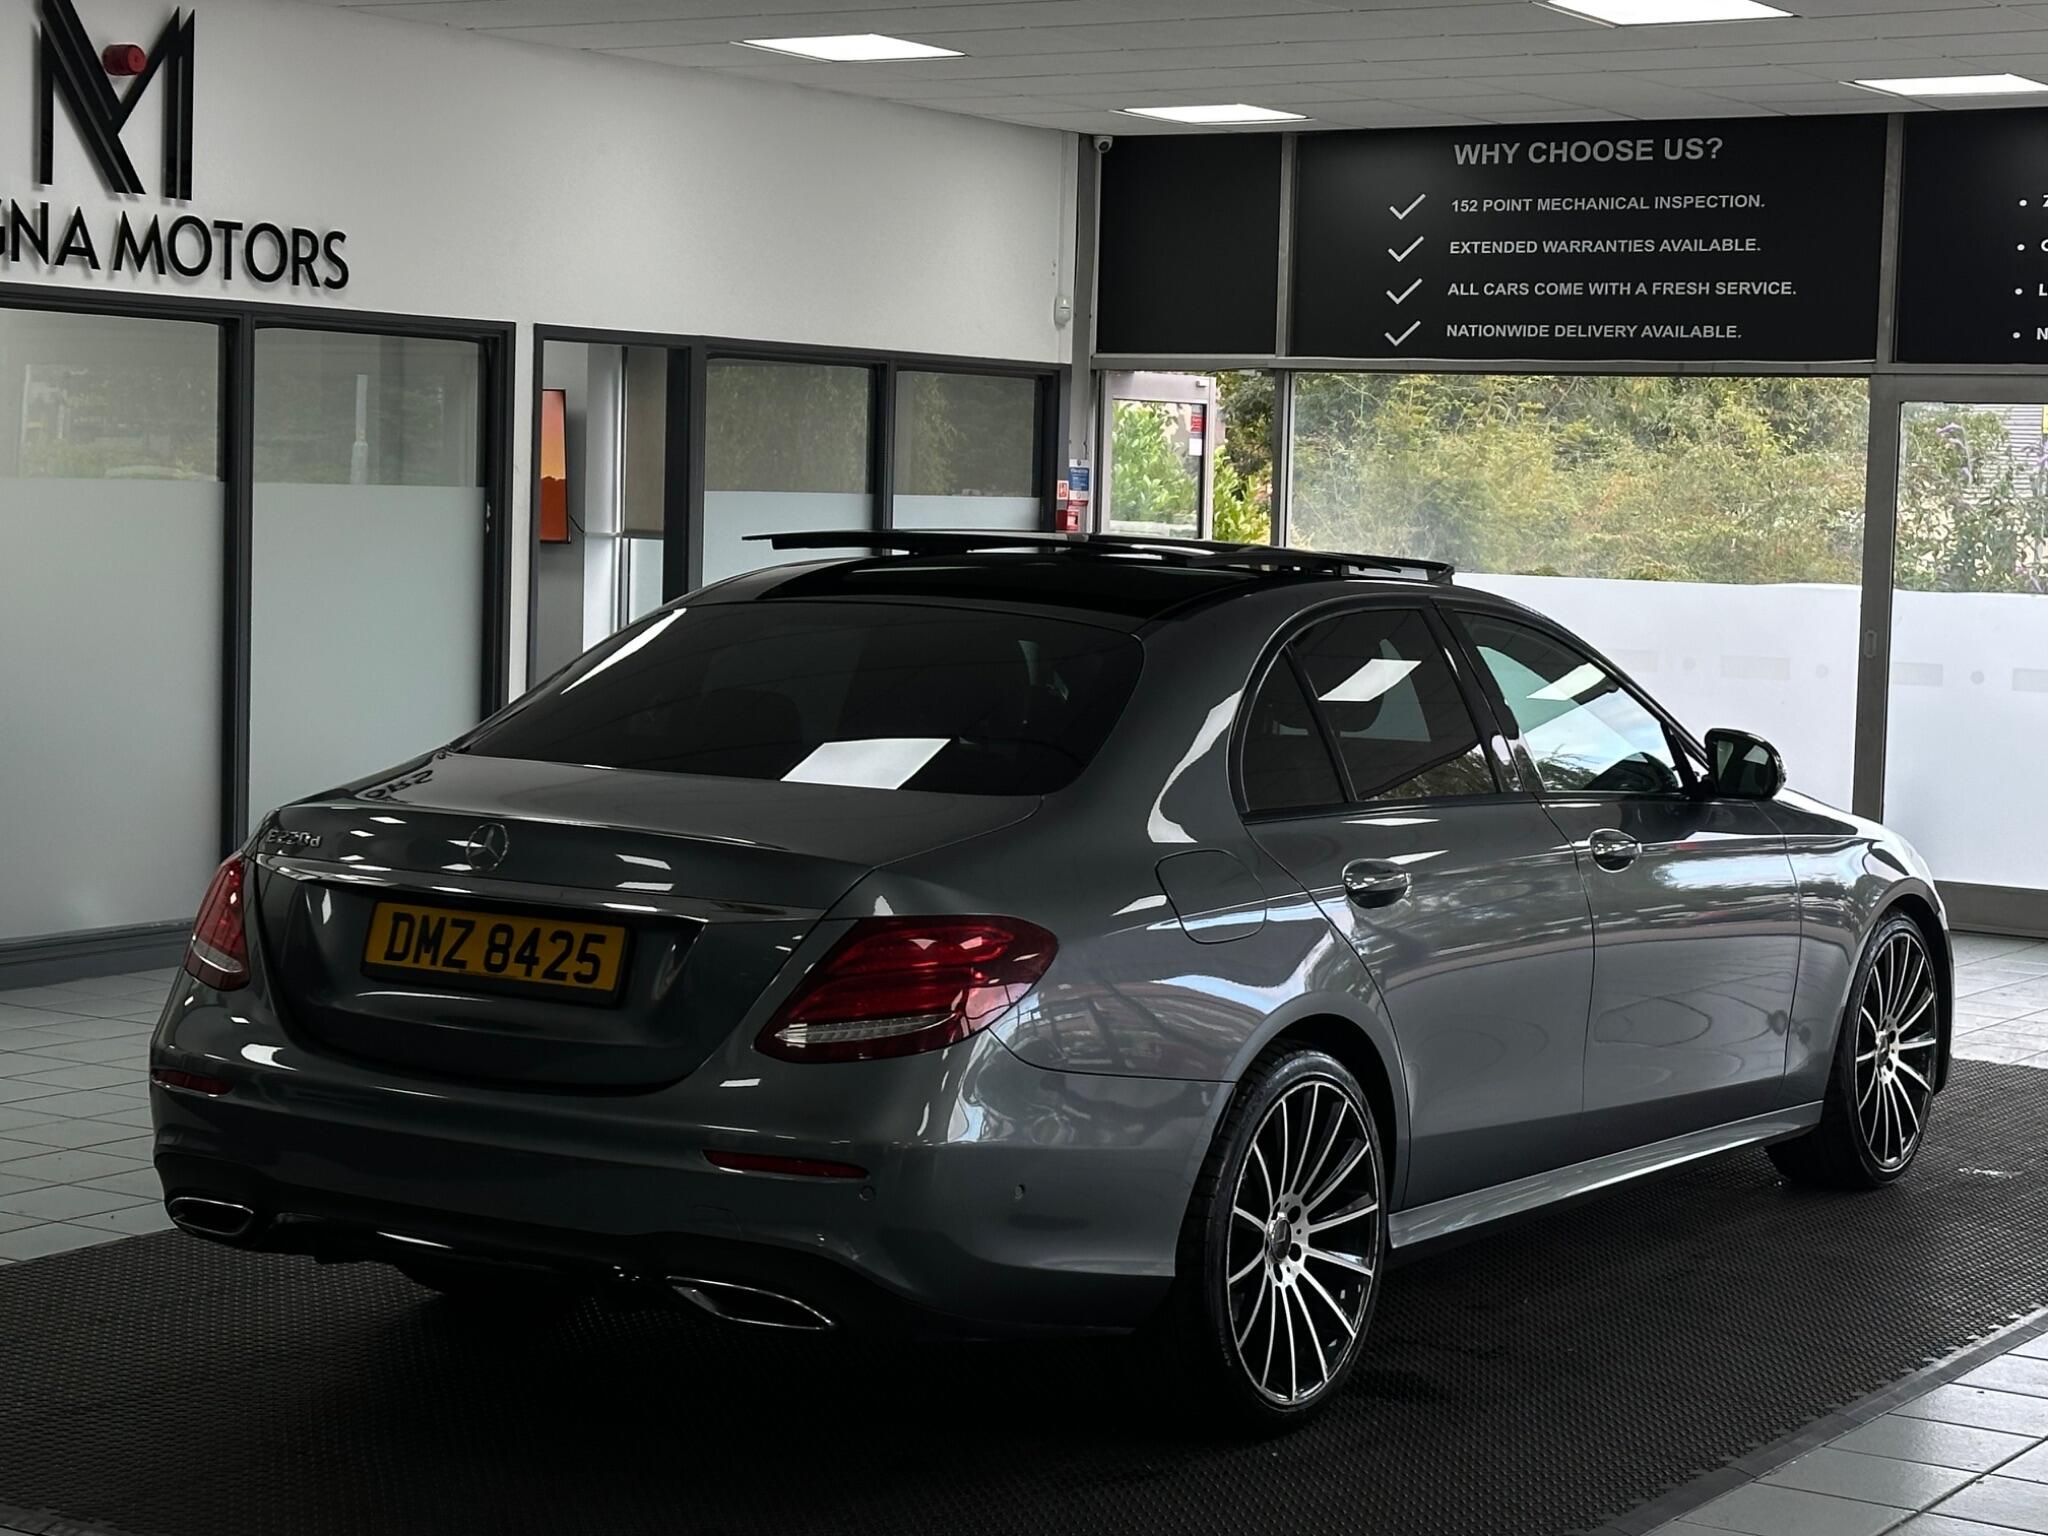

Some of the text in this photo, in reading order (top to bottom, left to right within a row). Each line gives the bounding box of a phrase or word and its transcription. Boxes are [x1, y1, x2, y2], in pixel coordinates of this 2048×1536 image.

[1454, 137, 1723, 165] WHY CHOOSE US?
[1451, 194, 1765, 213] 152 POINT MECHANICAL INSPECTION.
[0, 199, 349, 290] NA MOTORS
[1449, 238, 1761, 255] EXTENDED WARRANTIES AVAILABLE.
[1447, 281, 1797, 296] ALL CARS COME WITH A FRESH SERVICE.
[1446, 324, 1742, 339] NATIONWIDE DELIVERY AVAILABLE.
[383, 912, 607, 985] DMZ 8425
